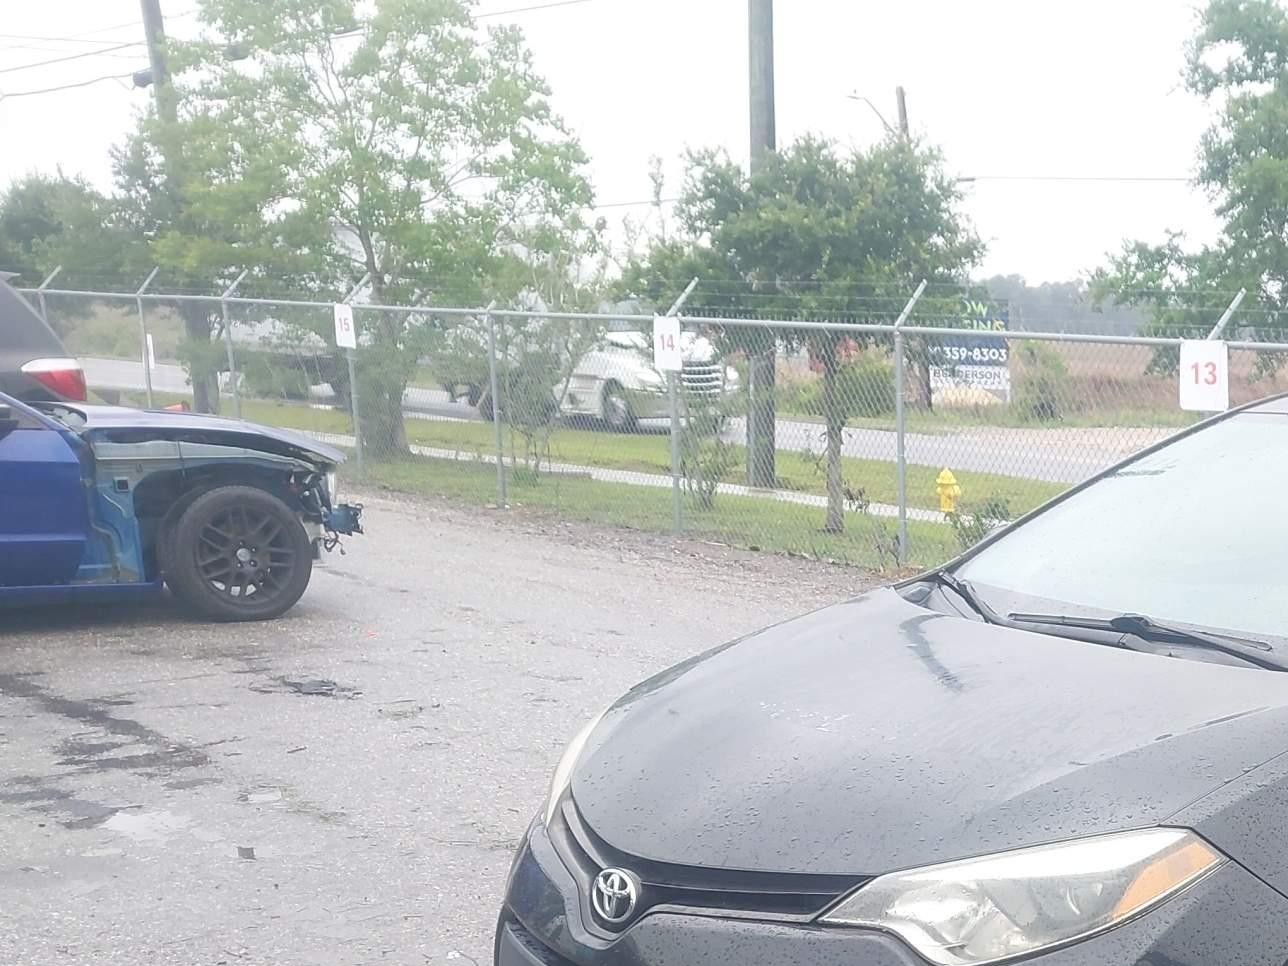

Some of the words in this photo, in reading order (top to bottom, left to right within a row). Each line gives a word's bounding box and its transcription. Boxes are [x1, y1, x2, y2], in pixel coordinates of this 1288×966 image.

[338, 317, 351, 332] 15
[660, 333, 676, 351] 14
[943, 347, 1007, 362] 359-8303
[1191, 361, 1217, 385] 13
